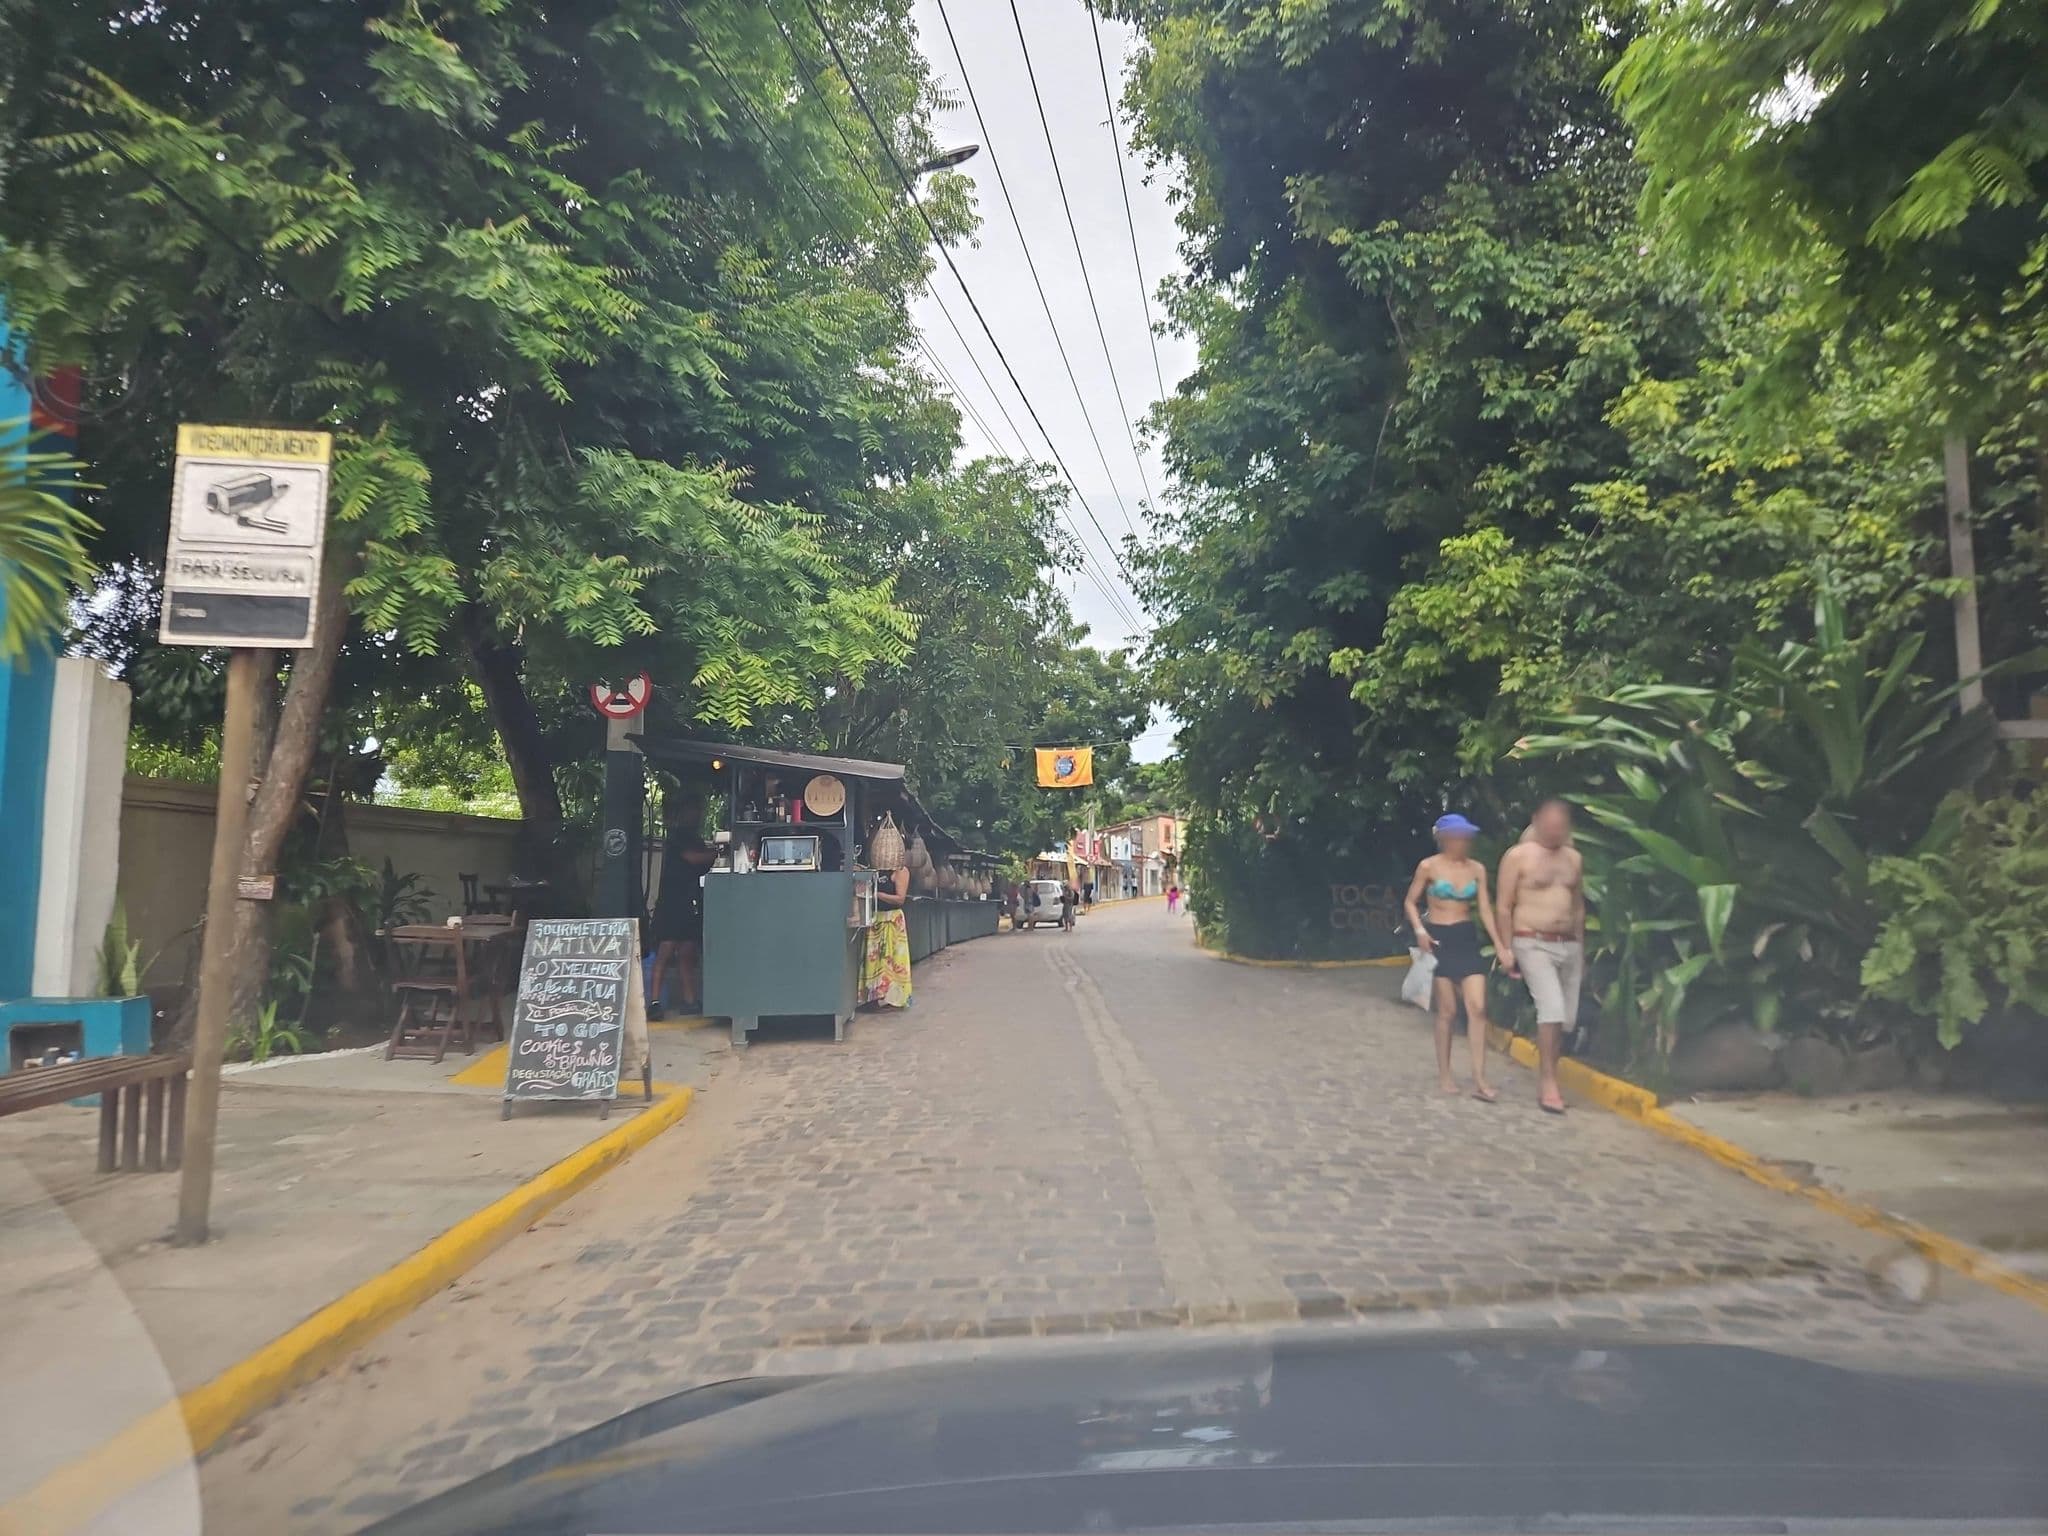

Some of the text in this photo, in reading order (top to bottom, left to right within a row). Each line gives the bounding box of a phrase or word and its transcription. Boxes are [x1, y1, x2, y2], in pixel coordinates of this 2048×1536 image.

[1328, 884, 1396, 905] TOCA
[532, 936, 621, 956] NATIVA
[535, 960, 617, 978] O MELHOR
[581, 979, 616, 1002] RUA
[534, 1022, 600, 1039] TO GO
[572, 1068, 616, 1090] GRÁTIS
